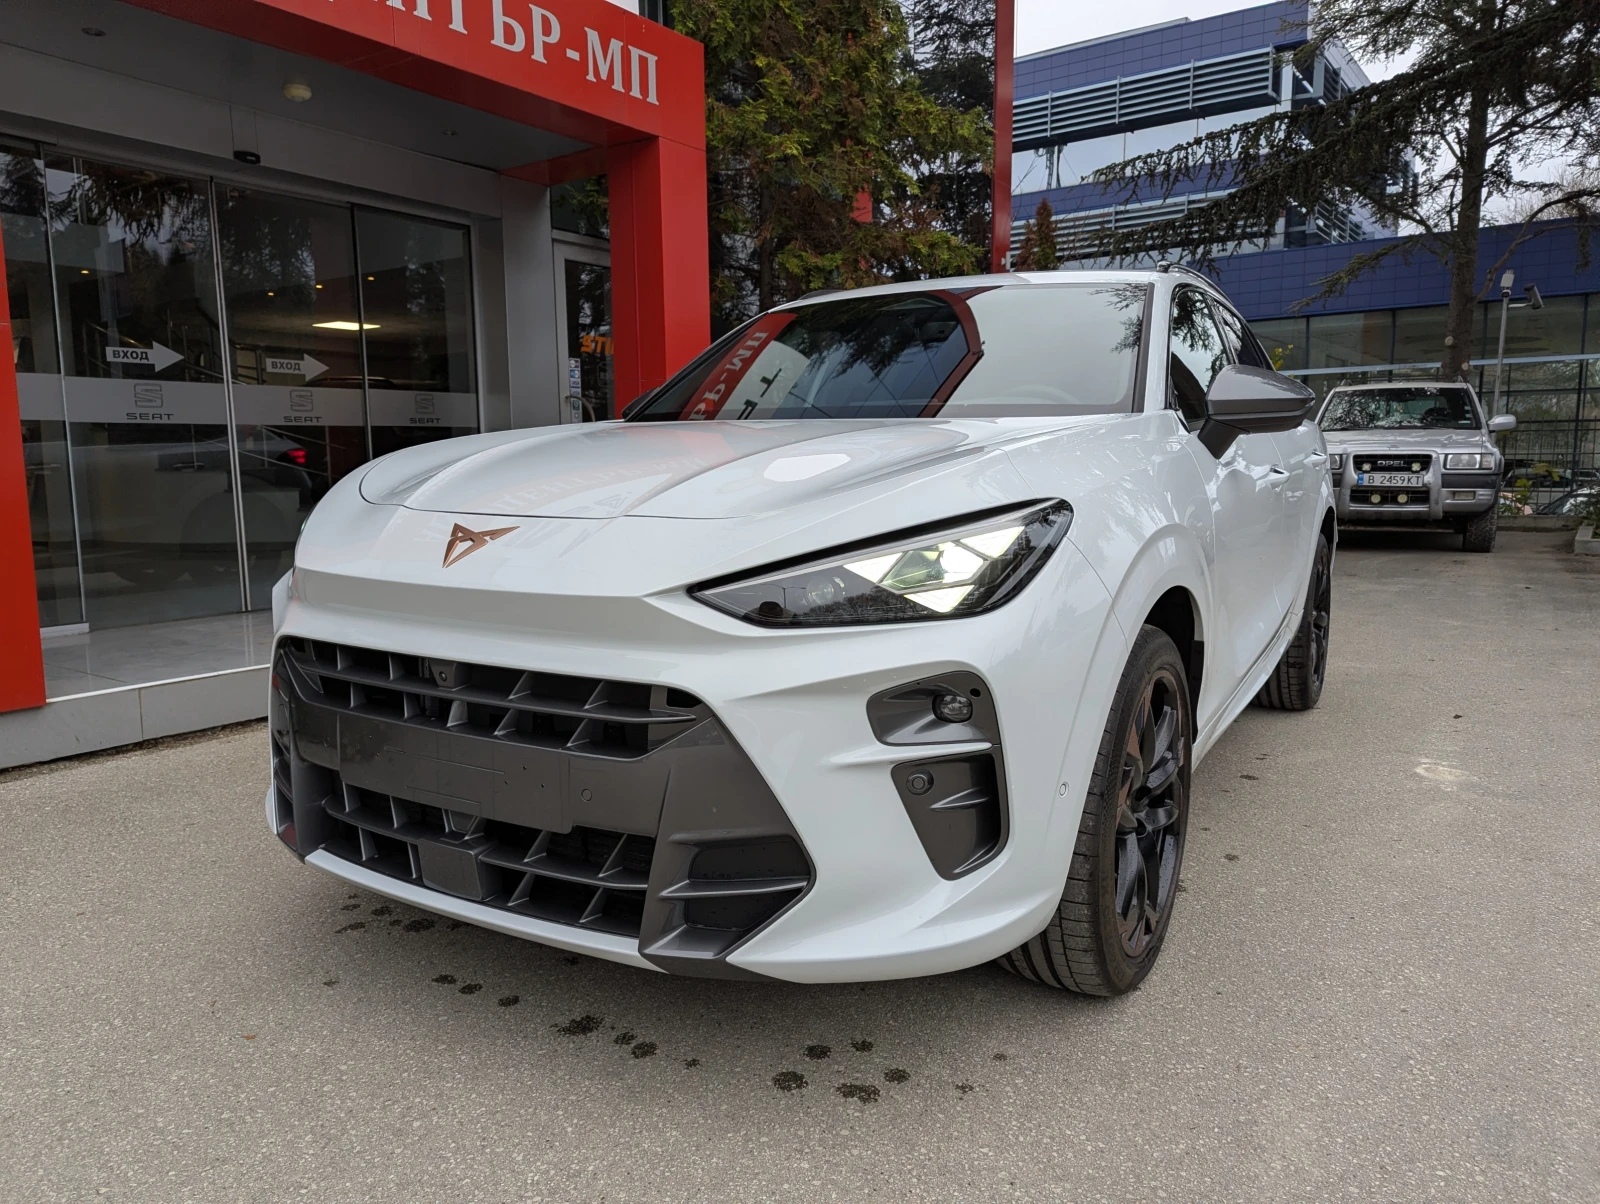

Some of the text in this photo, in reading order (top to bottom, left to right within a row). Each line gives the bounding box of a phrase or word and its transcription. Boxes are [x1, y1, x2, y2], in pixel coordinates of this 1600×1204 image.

[386, 0, 659, 105] ЪР-МП
[112, 348, 150, 362] ВХОД
[270, 360, 302, 372] ВХОД
[126, 412, 174, 422] SEAT
[283, 416, 322, 424] SEAT
[409, 417, 441, 425] SEAT
[1368, 475, 1375, 484] B
